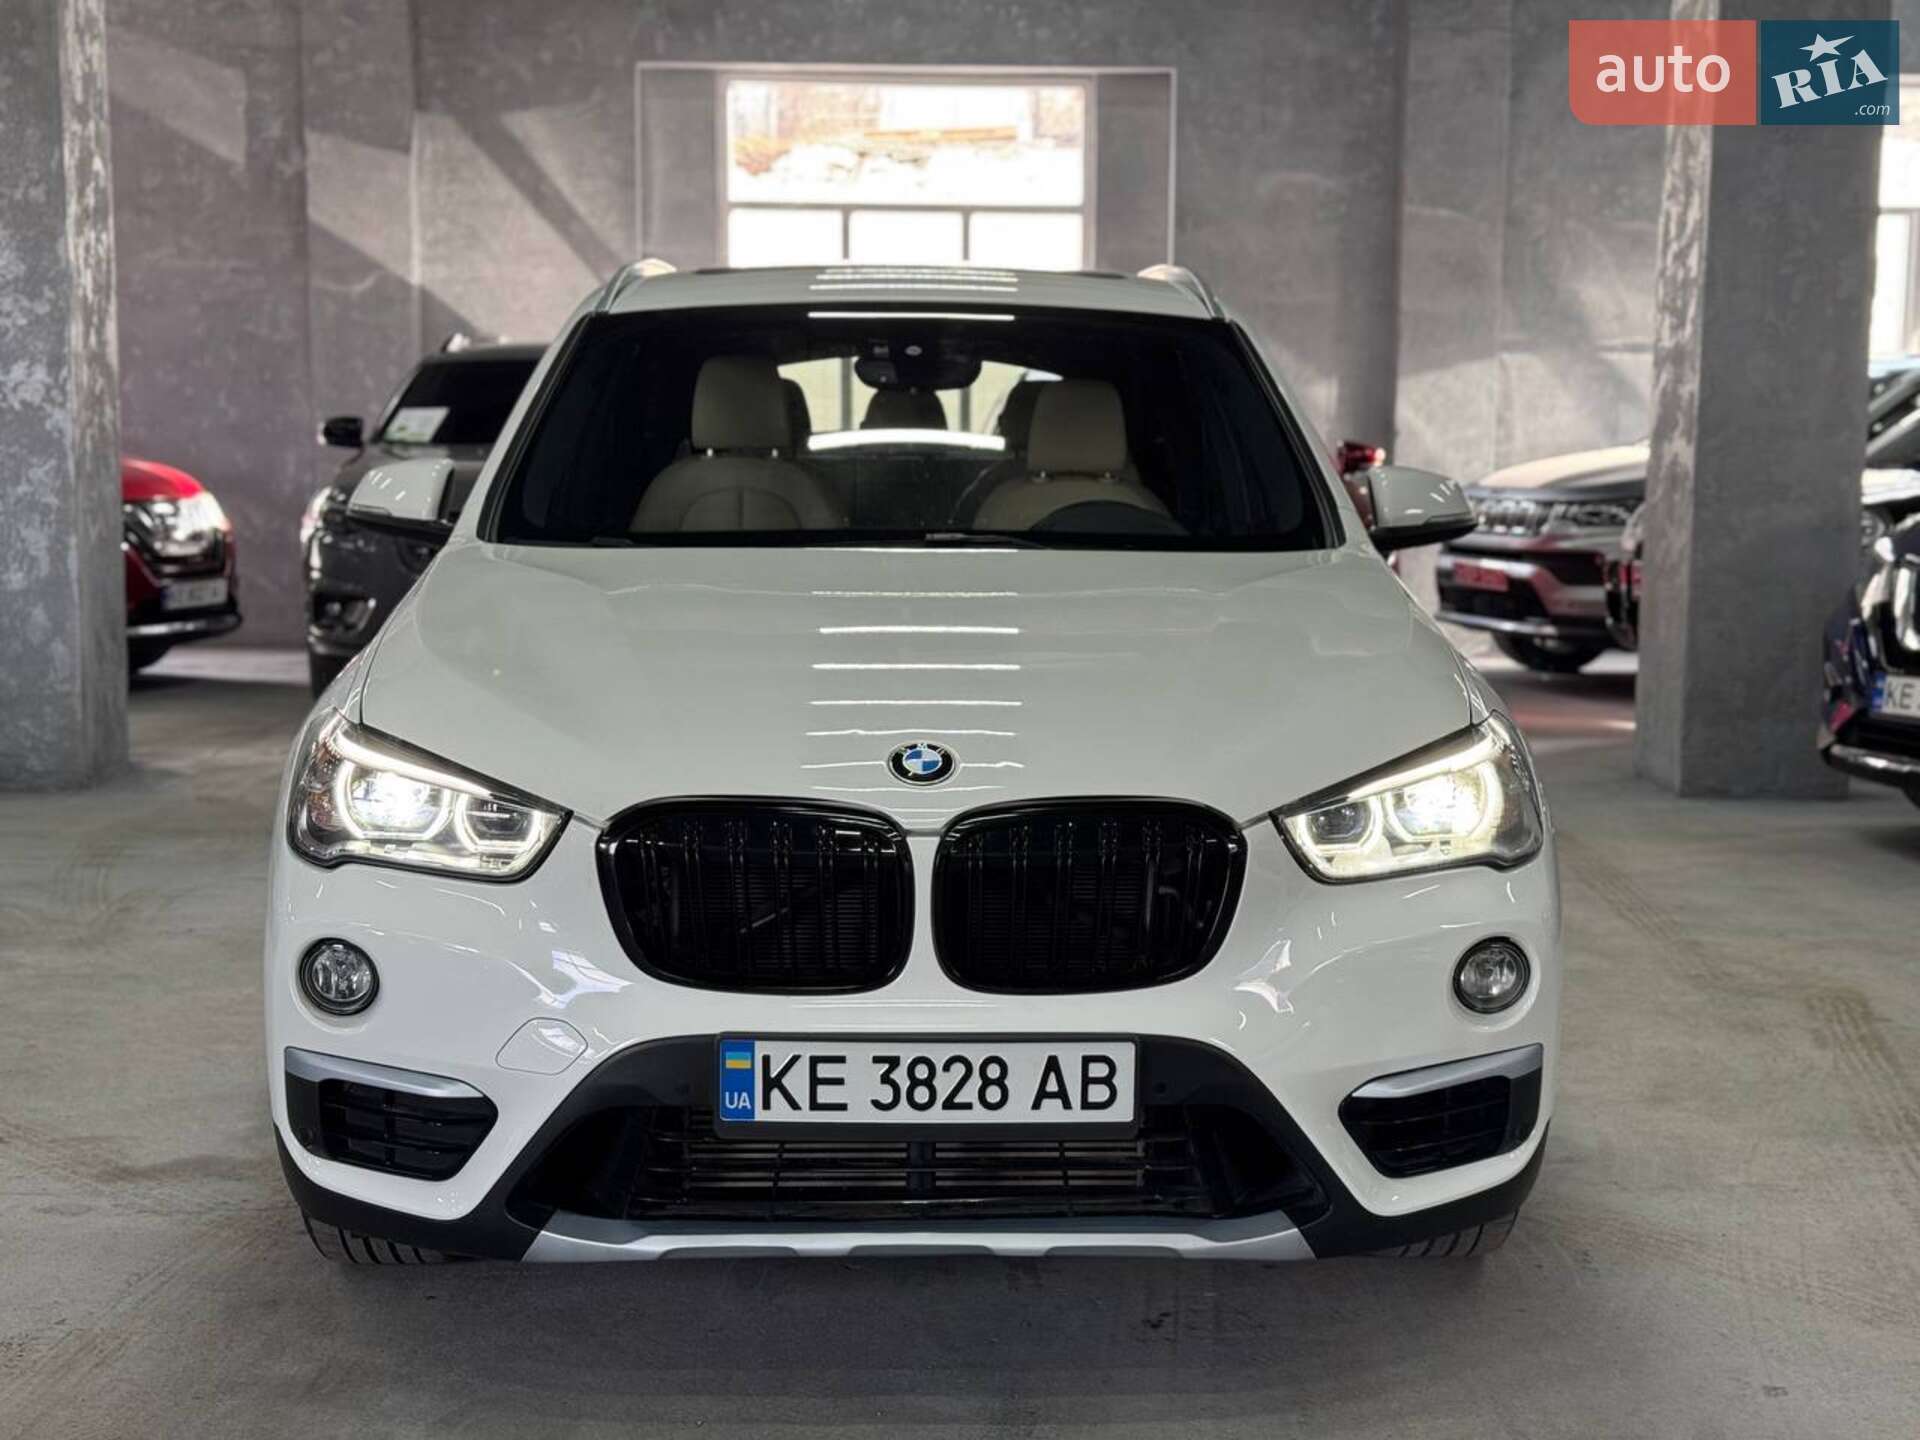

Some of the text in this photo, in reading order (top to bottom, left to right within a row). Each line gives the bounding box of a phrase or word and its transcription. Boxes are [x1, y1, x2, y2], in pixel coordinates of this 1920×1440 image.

[725, 1091, 752, 1109] UA
[761, 1054, 1118, 1112] KE 3828 AB
